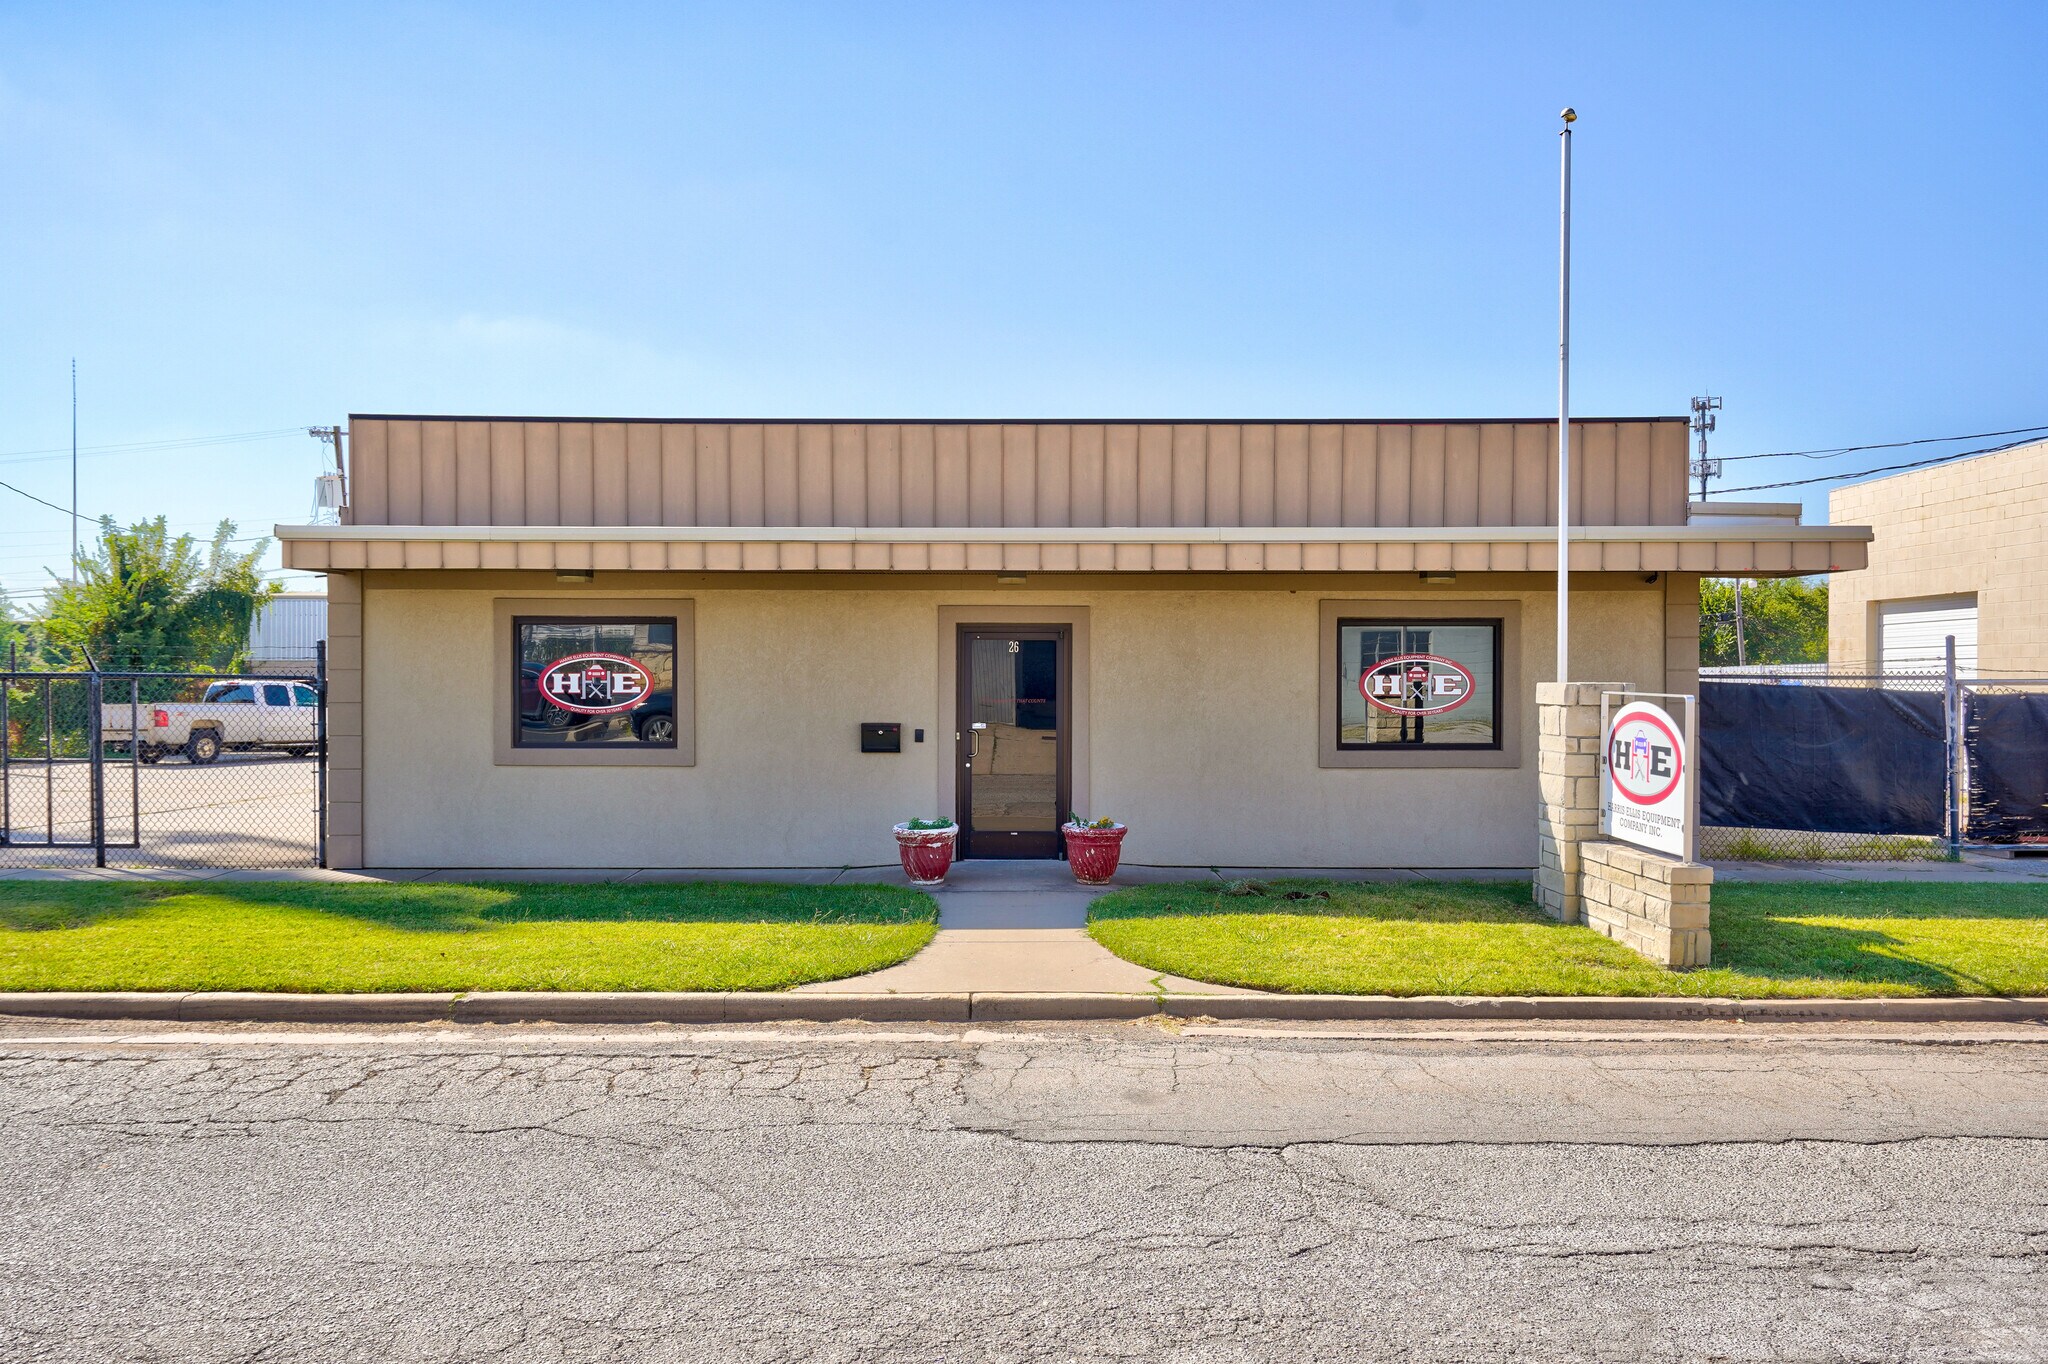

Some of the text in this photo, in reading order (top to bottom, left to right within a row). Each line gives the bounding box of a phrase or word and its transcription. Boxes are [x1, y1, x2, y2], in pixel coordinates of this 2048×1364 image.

[1008, 641, 1020, 653] 26
[551, 672, 641, 693] H E
[1372, 674, 1462, 696] H E
[1614, 740, 1672, 778] H E
[1607, 801, 1681, 830] HARRIS ELLIS EQUIPMENT
[1619, 817, 1663, 838] COMPANY INC.
